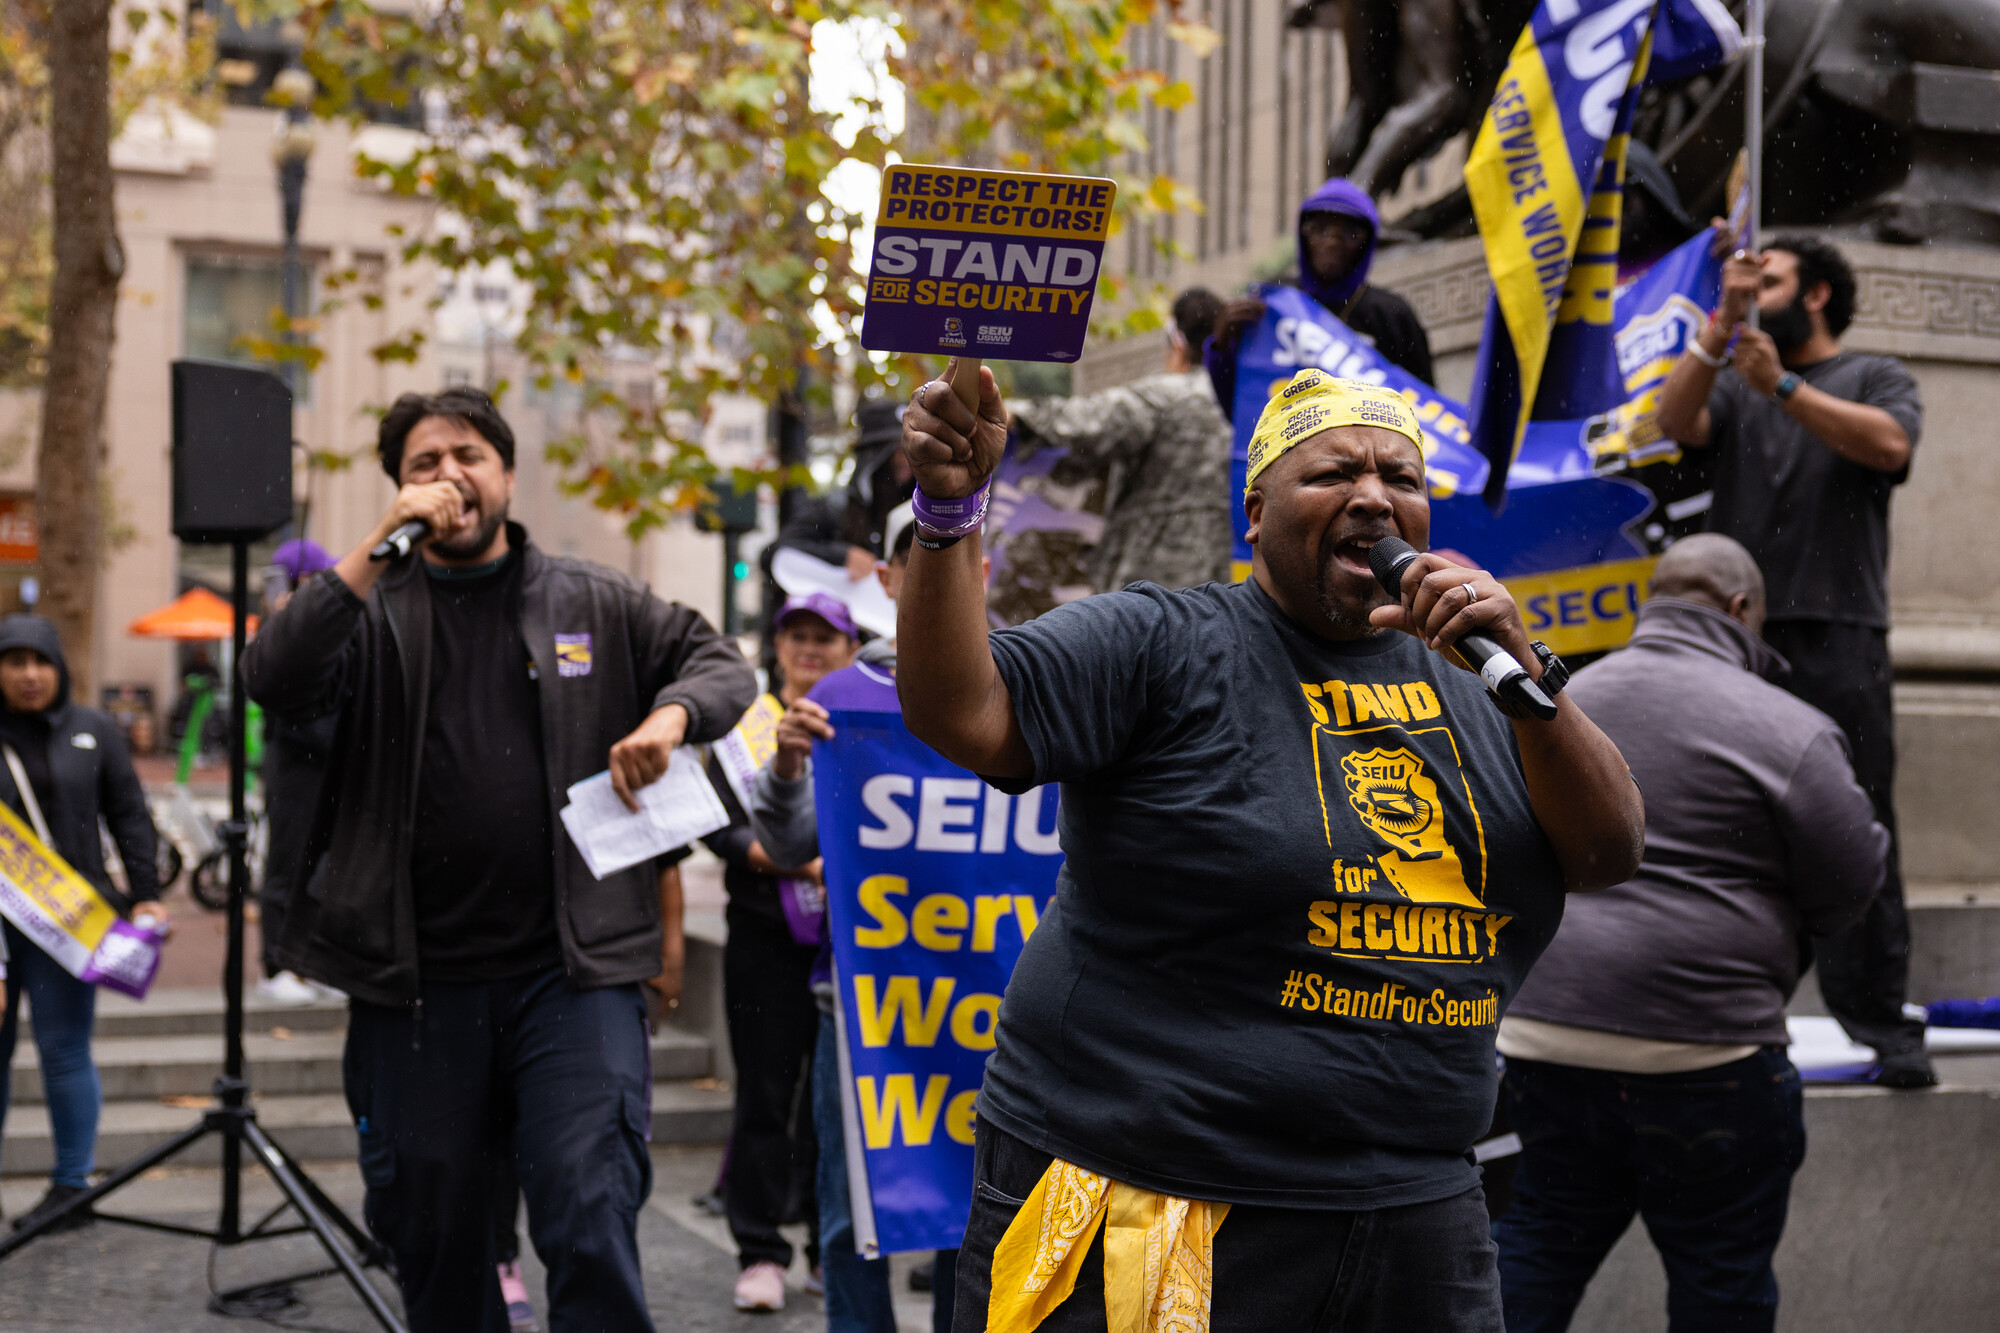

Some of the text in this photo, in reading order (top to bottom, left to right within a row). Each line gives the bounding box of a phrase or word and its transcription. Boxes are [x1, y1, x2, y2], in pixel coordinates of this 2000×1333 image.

[890, 172, 1109, 208] RESPECT THE
[886, 198, 1104, 232] PROTECTORS!
[875, 235, 1096, 287] STAND
[871, 280, 1090, 315] FOR SECURITY
[939, 337, 967, 346] STAND
[976, 334, 1012, 343] USWW
[978, 325, 1013, 336] SEIU
[1283, 377, 1321, 398] GREED
[1287, 405, 1320, 426] FIGHT
[1350, 406, 1407, 424] CORPORATE
[1361, 400, 1397, 413] FIGHT
[1280, 409, 1331, 437] CORPORATE
[1286, 418, 1323, 441] GREED
[1361, 412, 1402, 428] GREED
[1300, 680, 1442, 727] STAND
[1361, 764, 1405, 780] SEIU
[858, 773, 1066, 855] SEIU
[1307, 900, 1513, 957] SECURITY
